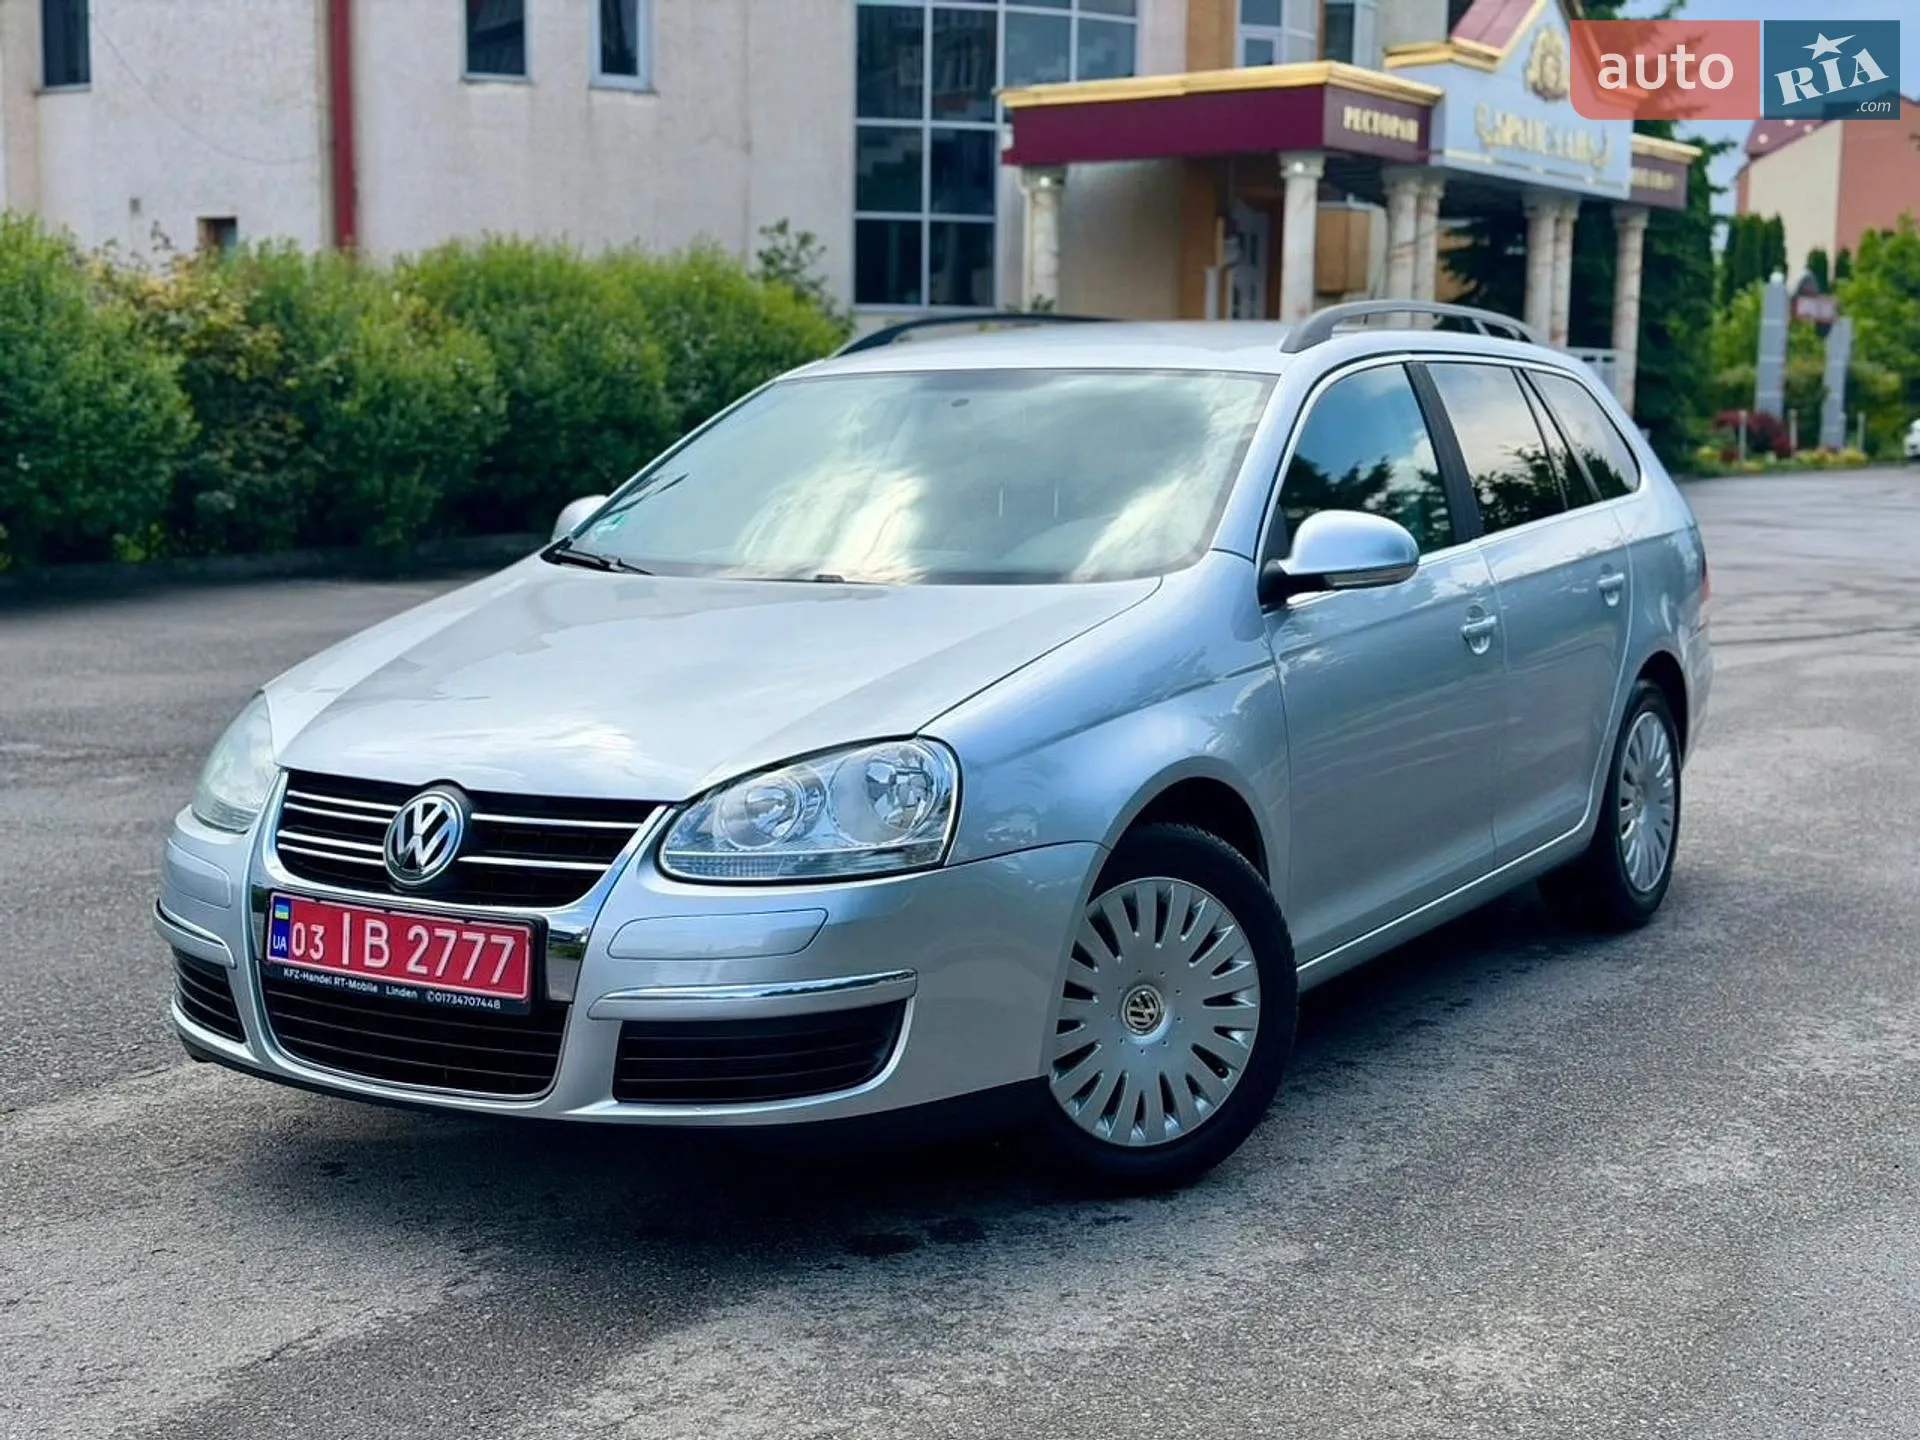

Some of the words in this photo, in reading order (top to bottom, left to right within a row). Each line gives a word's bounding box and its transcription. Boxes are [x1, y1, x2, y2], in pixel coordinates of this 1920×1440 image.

[272, 934, 288, 951] UA
[291, 922, 325, 960] 03
[342, 912, 391, 968] IB
[406, 925, 516, 985] 2777
[283, 967, 332, 984] KFZ-Handel
[333, 976, 379, 993] RT-Mobile
[386, 985, 418, 999] Linden
